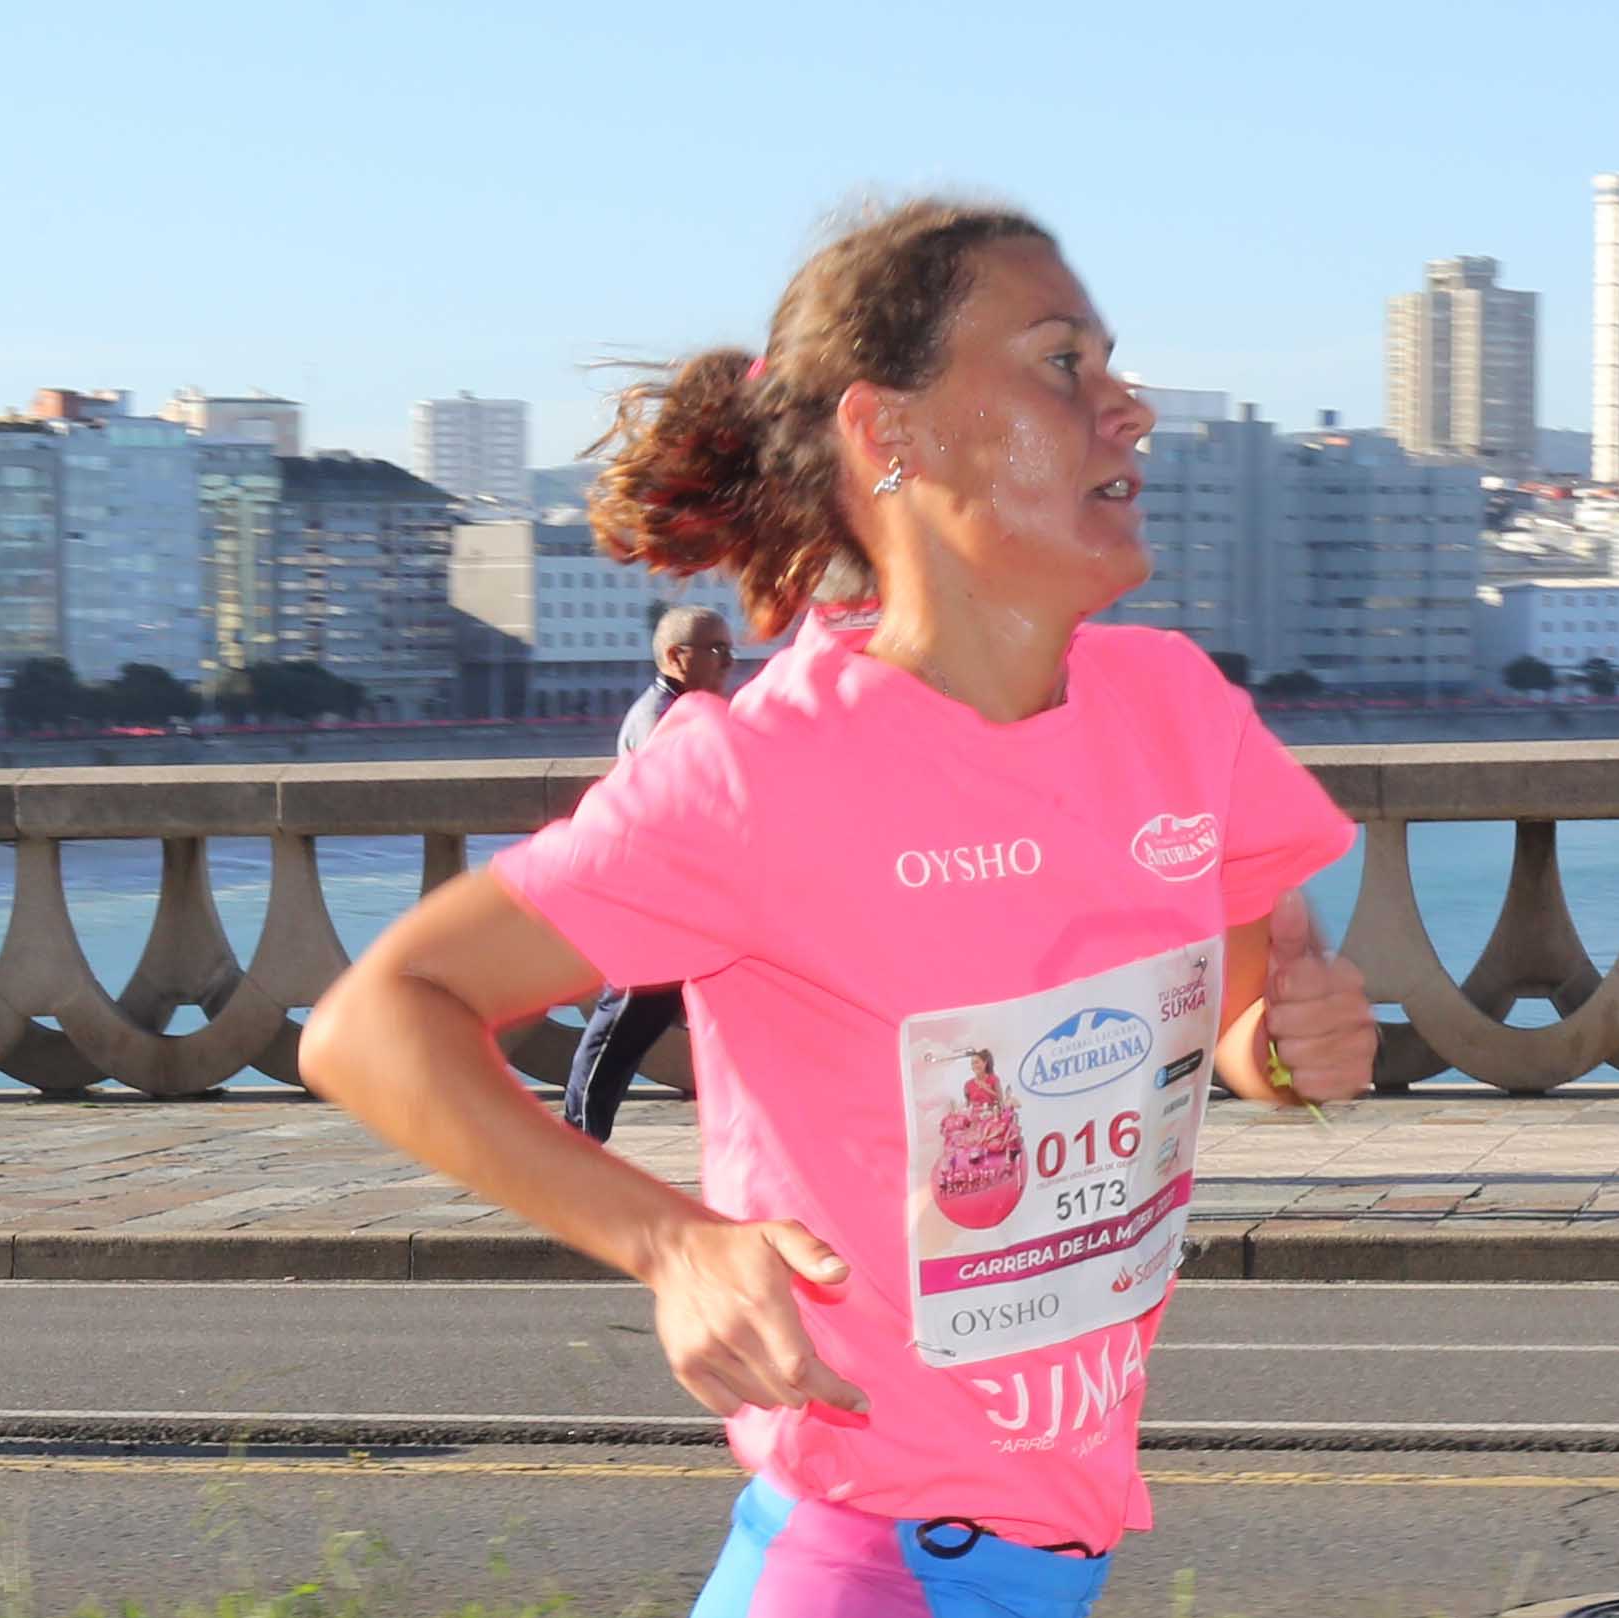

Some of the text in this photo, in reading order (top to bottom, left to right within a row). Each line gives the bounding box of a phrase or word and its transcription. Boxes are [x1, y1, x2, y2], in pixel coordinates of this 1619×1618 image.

[896, 837, 1042, 888] OYSHO
[1161, 990, 1205, 1022] SUMA
[1031, 1035, 1144, 1086] ASTURIANA
[1037, 1110, 1141, 1178] 016
[1057, 1179, 1127, 1221] 5173
[959, 1246, 1055, 1280] CARRERA
[1059, 1235, 1084, 1260] DE
[1086, 1229, 1111, 1250] LA
[951, 1293, 1060, 1337] OYSHO
